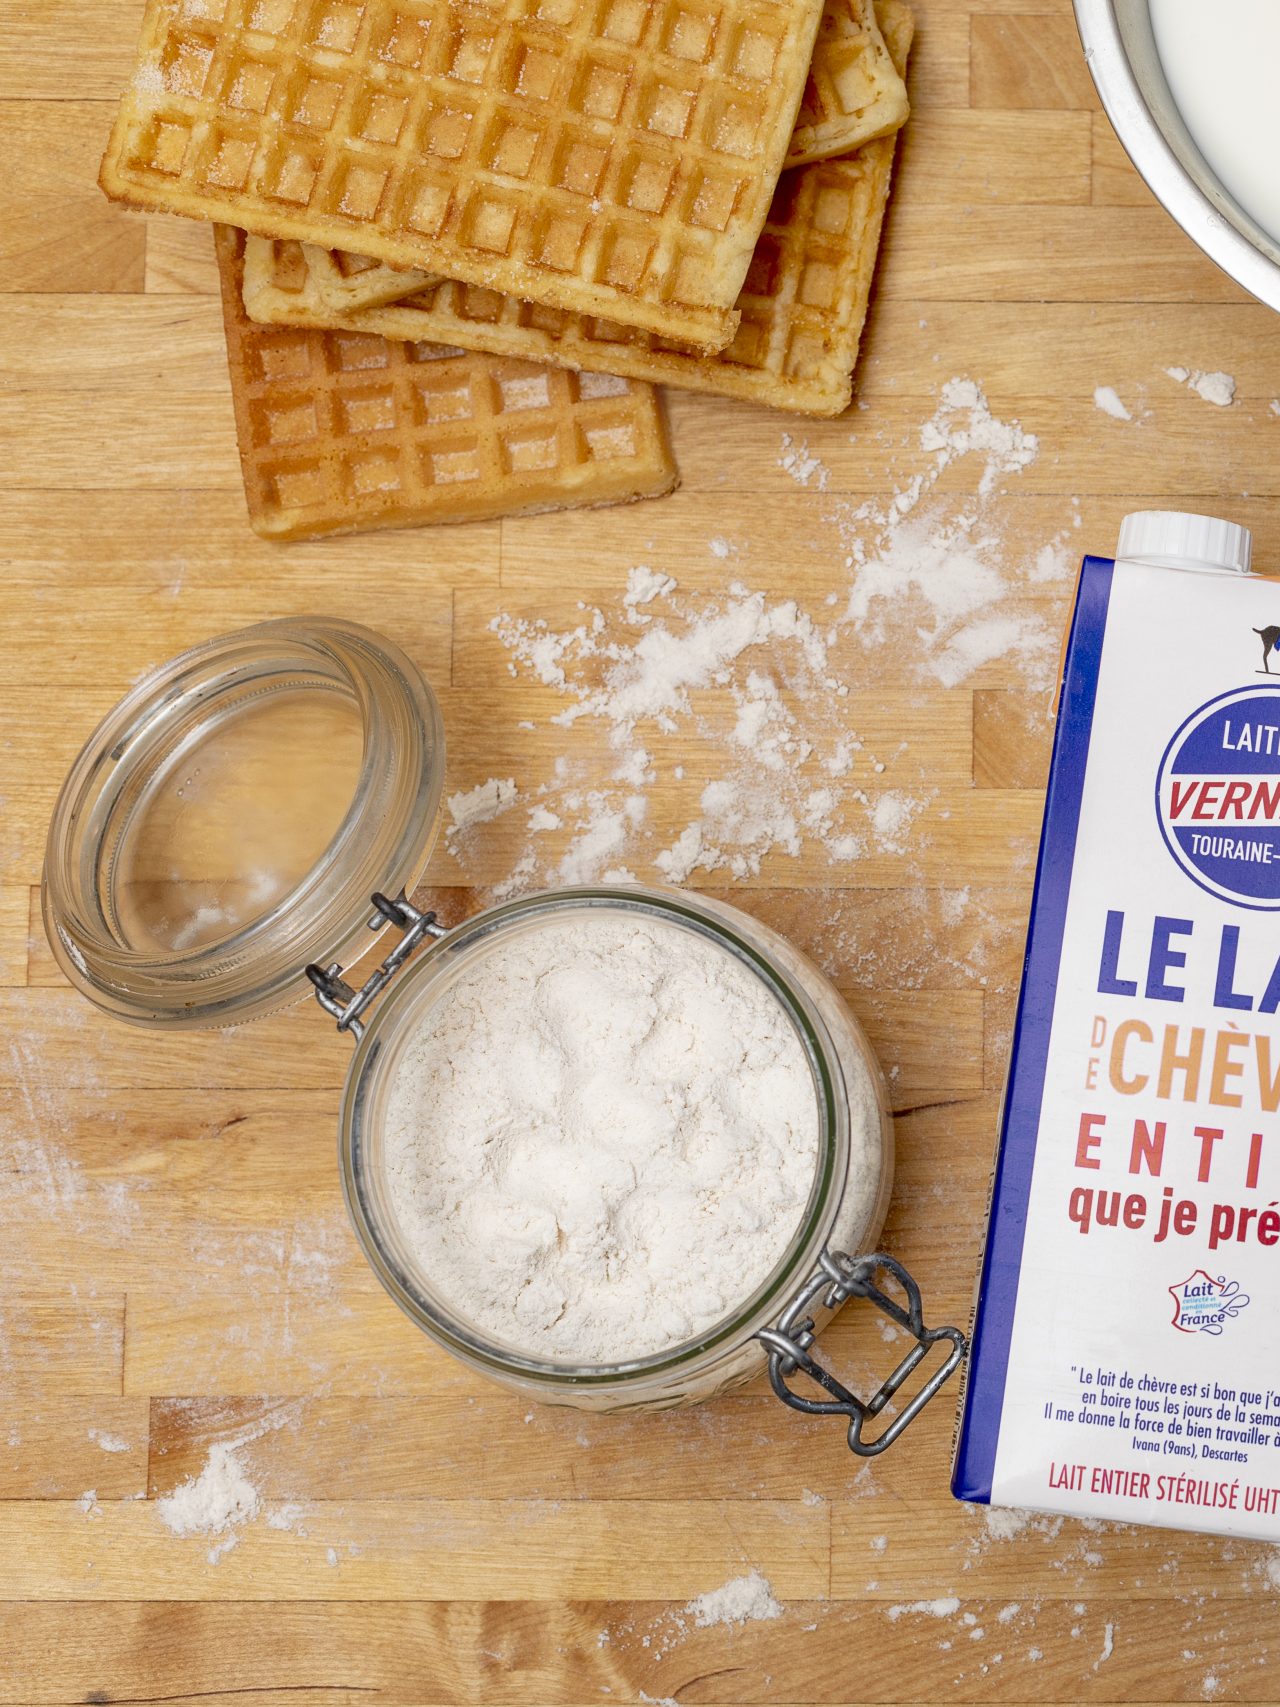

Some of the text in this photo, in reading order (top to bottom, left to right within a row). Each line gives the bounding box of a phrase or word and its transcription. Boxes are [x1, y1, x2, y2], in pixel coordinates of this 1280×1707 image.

[1097, 910, 1194, 1003] LE
[1068, 1186, 1147, 1235] que
[1154, 1187, 1198, 1243] je
[1184, 1282, 1213, 1297] Lait
[1180, 1313, 1226, 1326] France
[1079, 1367, 1093, 1385] Le
[1096, 1367, 1117, 1388] lait
[1119, 1371, 1134, 1390] de
[1137, 1373, 1178, 1395] chèvre
[1180, 1383, 1198, 1398] est
[1200, 1384, 1211, 1399] si
[1213, 1381, 1236, 1402] bon
[1239, 1391, 1263, 1408] que
[1081, 1392, 1097, 1405] en
[1100, 1388, 1132, 1410] boire
[1135, 1396, 1160, 1413] tous
[1163, 1395, 1180, 1415] les
[1182, 1401, 1213, 1420] jours
[1216, 1403, 1232, 1422] de
[1234, 1405, 1246, 1423] la
[1044, 1401, 1053, 1420] Il
[1055, 1409, 1075, 1423] me
[1078, 1406, 1116, 1428] donne
[1119, 1410, 1131, 1429] la
[1134, 1412, 1165, 1434] force
[1167, 1417, 1183, 1436] de
[1186, 1419, 1212, 1439] bien
[1216, 1425, 1271, 1447] travailler
[1132, 1435, 1249, 1463] Ivana (9ans), Descartes
[1048, 1461, 1087, 1492] LAIT
[1090, 1467, 1151, 1499] ENTIER
[1155, 1471, 1240, 1510] STÉRILISÉ
